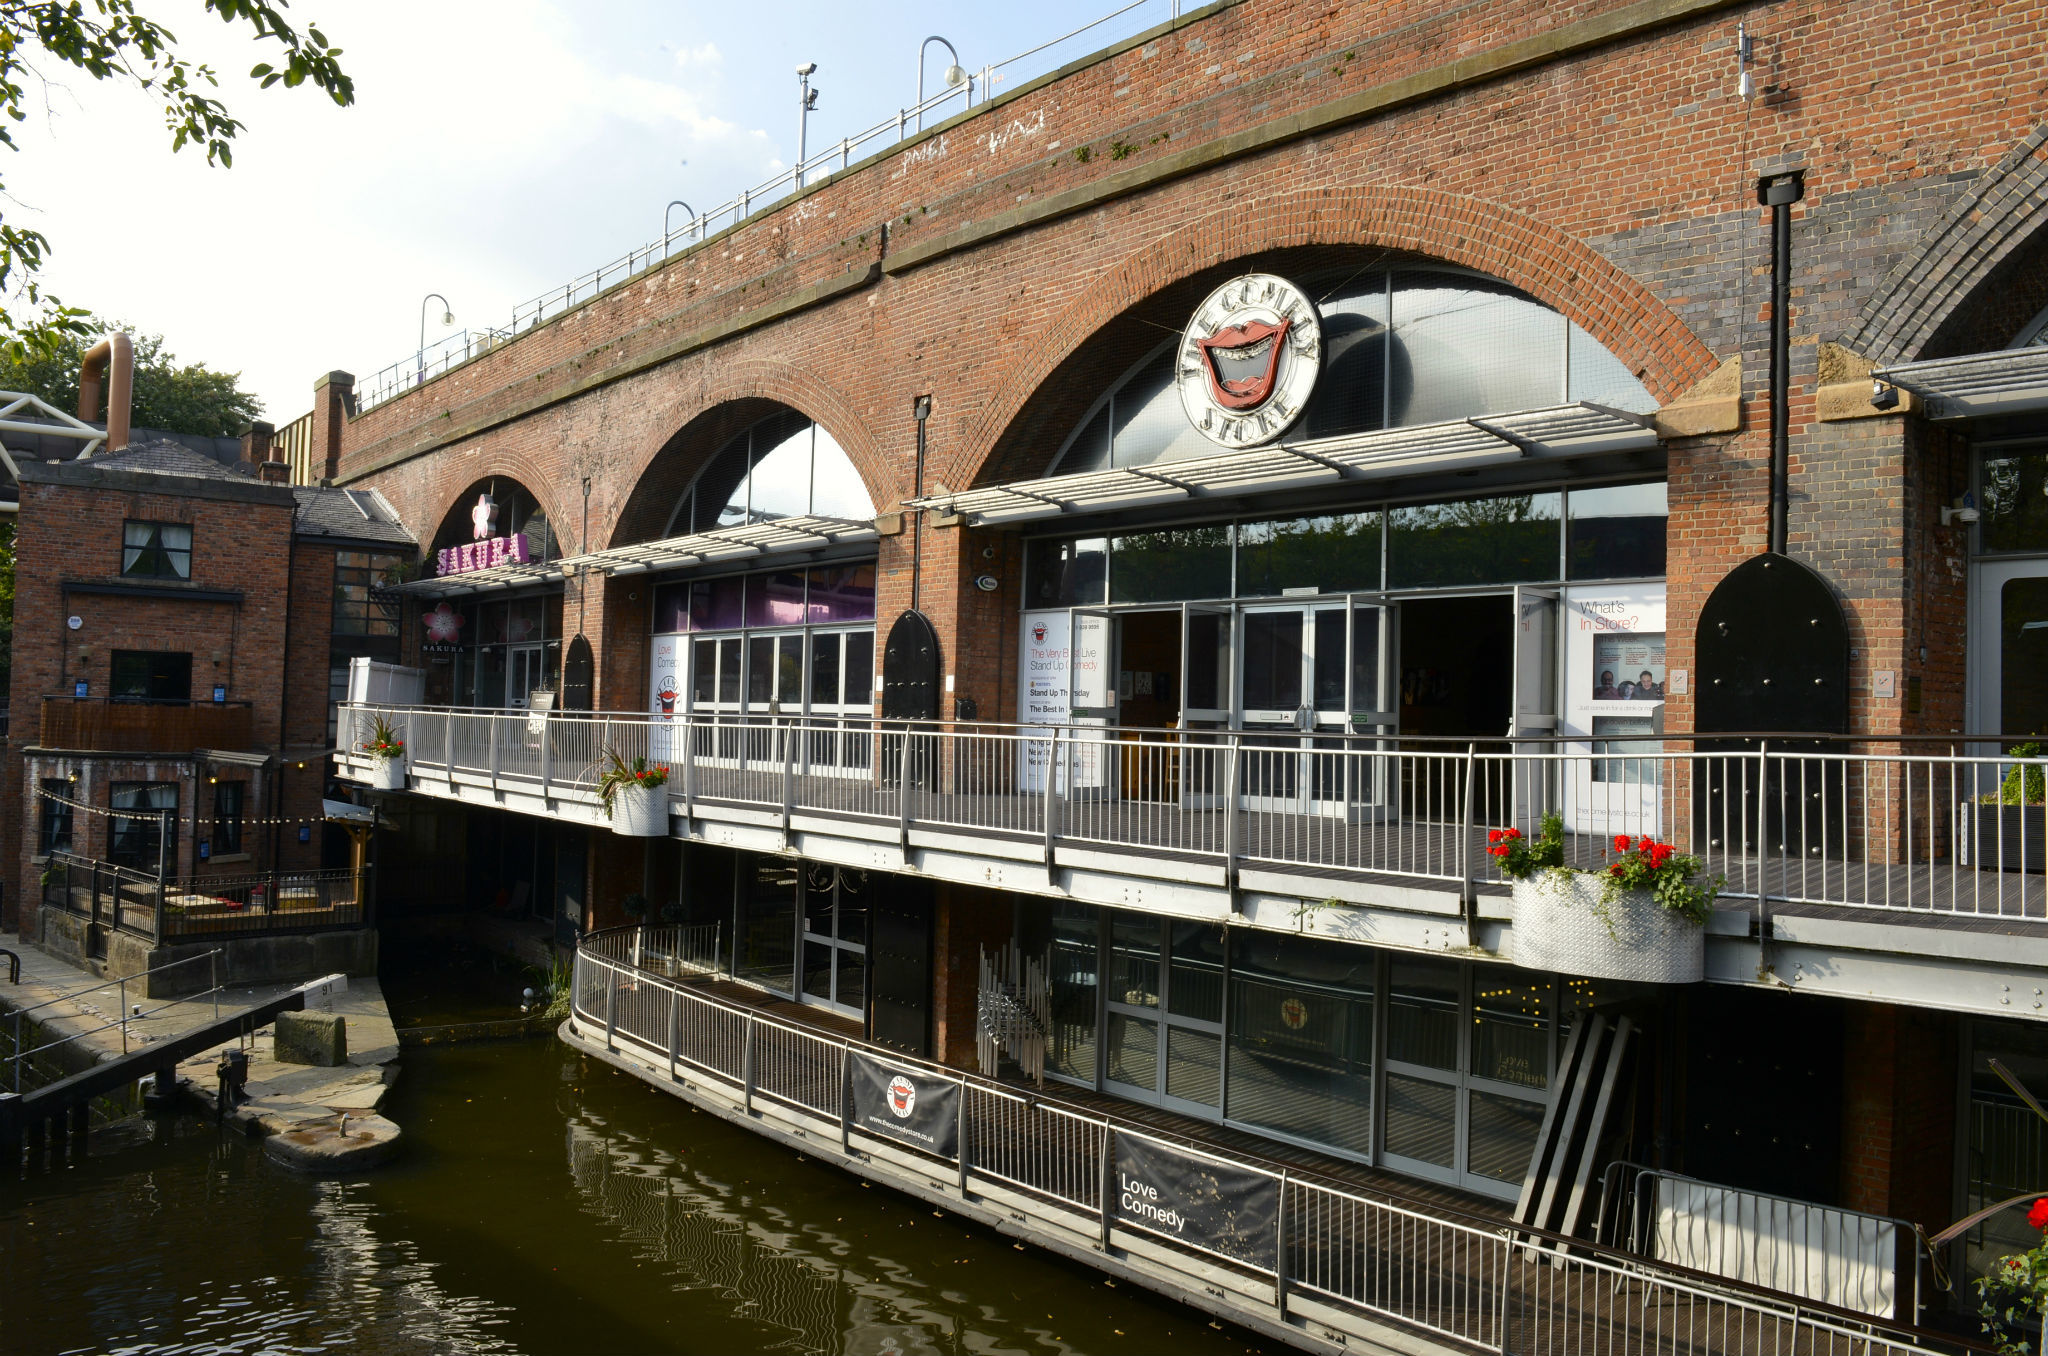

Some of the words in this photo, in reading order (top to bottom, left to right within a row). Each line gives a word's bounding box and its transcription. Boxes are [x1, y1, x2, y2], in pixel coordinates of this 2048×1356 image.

[1221, 278, 1316, 361] COMEDY
[1200, 391, 1297, 442] STORE
[436, 533, 521, 576] SAKURA
[1580, 600, 1625, 614] What's
[1580, 616, 1592, 631] In
[1595, 615, 1639, 631] Store?
[423, 645, 464, 653] SAKURA
[657, 646, 672, 655] Love
[1031, 648, 1044, 658] The
[1046, 648, 1062, 660] Very
[1081, 647, 1097, 658] Live
[1030, 660, 1052, 671] Stand
[1053, 661, 1064, 672] Up
[1029, 689, 1048, 697] Stand
[1049, 689, 1058, 698] Up
[1029, 705, 1041, 713] The
[1042, 705, 1057, 713] Best
[1058, 705, 1065, 713] In
[1028, 748, 1043, 756] New
[1028, 758, 1043, 766] New
[322, 983, 333, 996] 91
[868, 1115, 935, 1144] www.thecomedystore.co.uk
[1122, 1172, 1158, 1200] Love
[1121, 1192, 1185, 1233] Comedy
